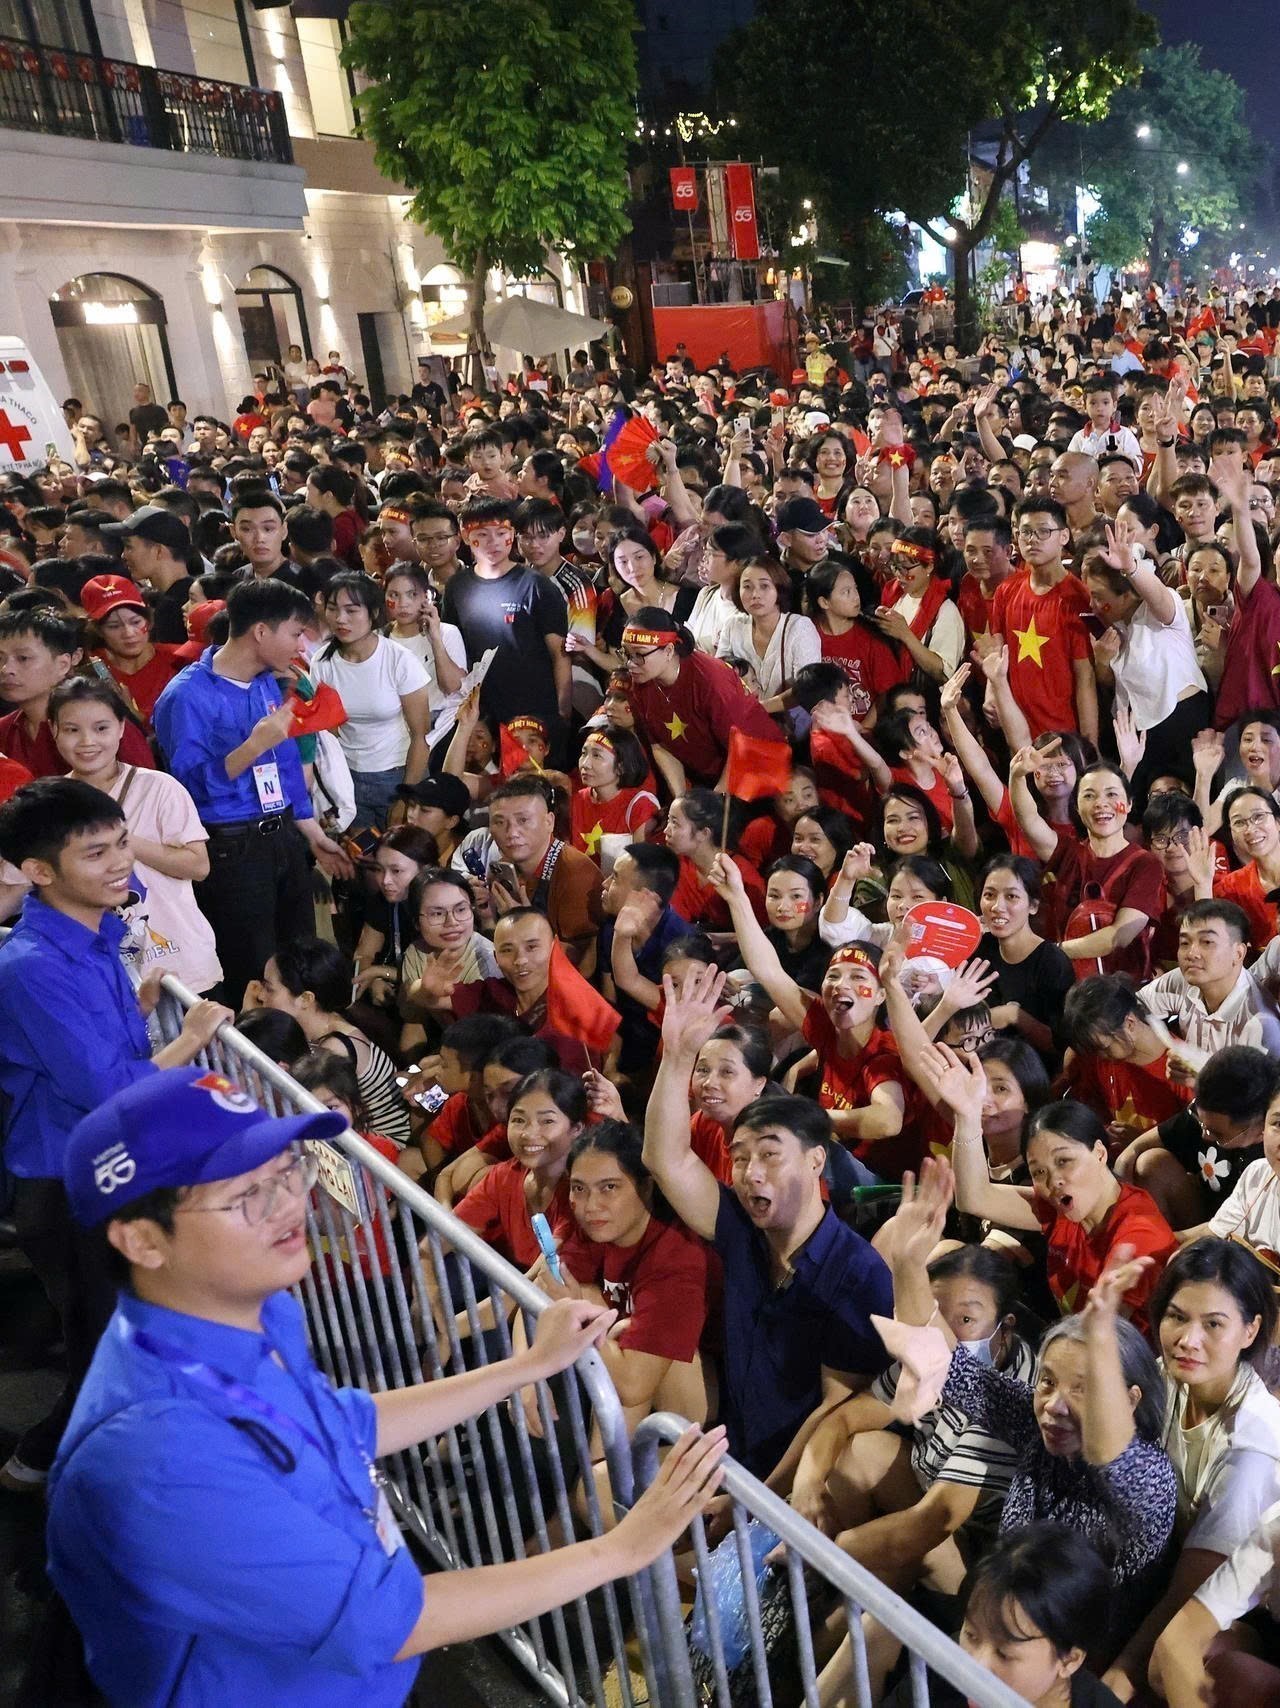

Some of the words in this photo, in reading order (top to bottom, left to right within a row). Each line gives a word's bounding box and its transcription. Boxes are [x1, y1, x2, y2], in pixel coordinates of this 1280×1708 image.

[676, 185, 693, 198] 5G
[735, 209, 752, 222] 5G
[8, 398, 37, 425] THACO
[637, 634, 651, 643] NAM
[264, 781, 275, 795] N
[95, 1152, 136, 1194] 5G
